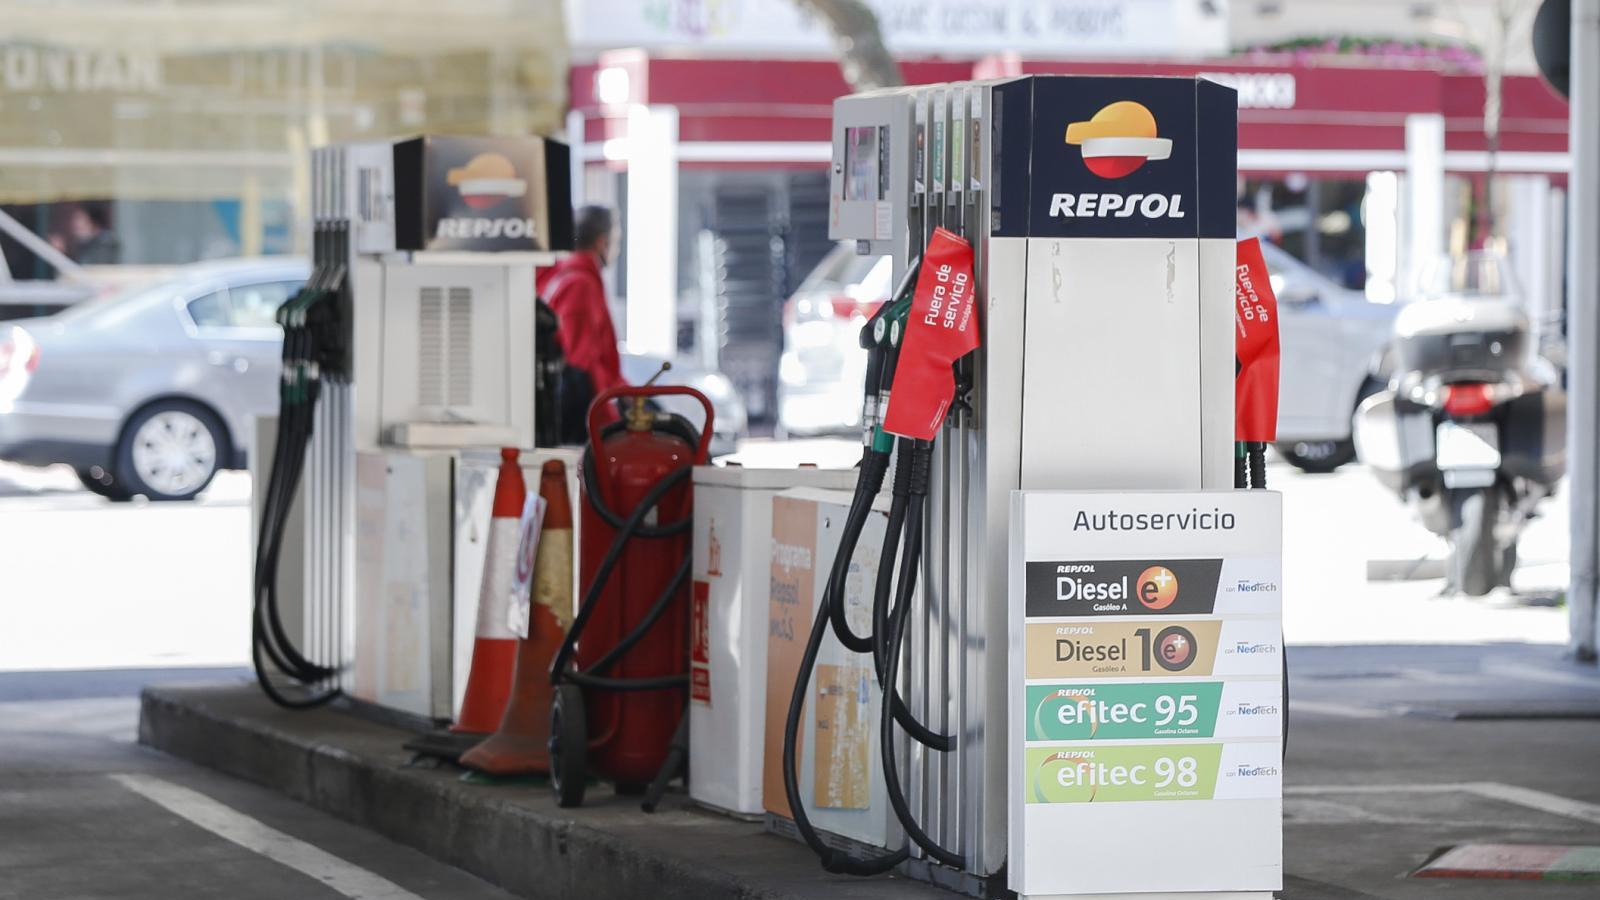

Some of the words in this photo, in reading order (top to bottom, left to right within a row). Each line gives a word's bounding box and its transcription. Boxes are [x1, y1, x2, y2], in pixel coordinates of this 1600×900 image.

[1049, 193, 1185, 218] REPSOL
[436, 217, 535, 239] REPSOL
[935, 263, 952, 283] de
[943, 272, 968, 329] servicio
[1237, 263, 1259, 302] Fuera
[1256, 305, 1269, 322] de
[924, 285, 947, 326] Fuera
[1073, 508, 1236, 531] Autoservicio
[1056, 565, 1096, 573] REPSOL
[1056, 576, 1128, 601] Diesel
[1225, 585, 1236, 593] con
[1237, 582, 1277, 592] NeoTech
[1055, 626, 1095, 635] REPSOL
[1056, 638, 1127, 662] Diesel
[1224, 647, 1235, 655] con
[1236, 644, 1276, 654] NeoTech
[1057, 688, 1096, 697] REPSOL
[1057, 700, 1148, 725] efitec
[1154, 695, 1199, 727] 95
[1226, 708, 1237, 716] con
[1238, 705, 1278, 716] NeoTech
[1057, 751, 1096, 760] REPSOL
[1057, 762, 1148, 787] efitec
[1154, 756, 1199, 788] 98
[1226, 770, 1237, 778] con
[1238, 766, 1278, 777] NeoTech
